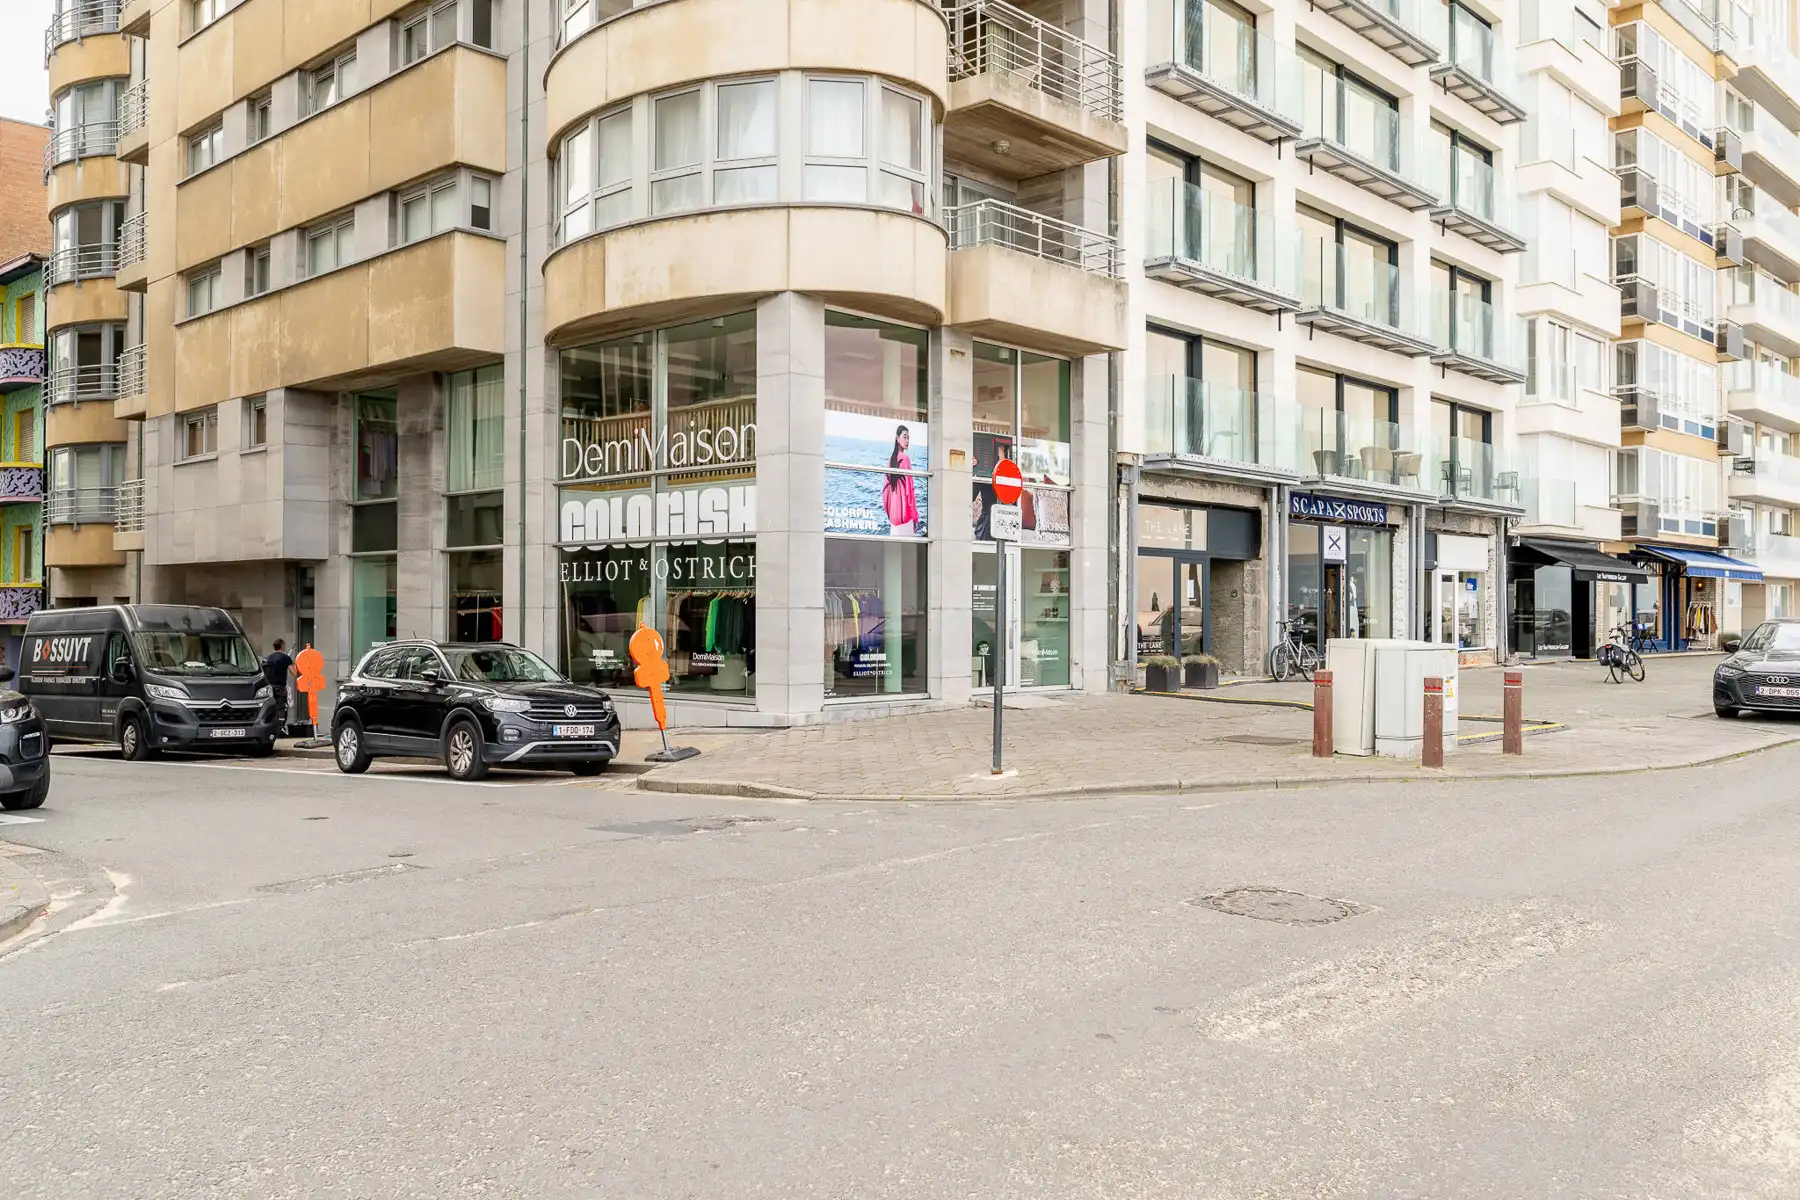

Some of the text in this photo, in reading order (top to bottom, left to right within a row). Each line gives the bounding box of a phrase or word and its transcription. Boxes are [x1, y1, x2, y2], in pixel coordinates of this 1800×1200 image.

[563, 420, 757, 478] DemiMaison
[561, 486, 757, 552] COLORISH
[824, 506, 876, 519] OLORFUL
[1293, 497, 1385, 523] SCAPA SPORTS
[824, 517, 881, 531] ASHMERE.
[1145, 520, 1190, 535] THE LANE
[560, 559, 633, 582] ELLIOT
[639, 558, 649, 571] &
[33, 637, 92, 662] BOSSUYT
[1150, 641, 1162, 649] LANE
[1760, 688, 1800, 696] 2-DPK-055
